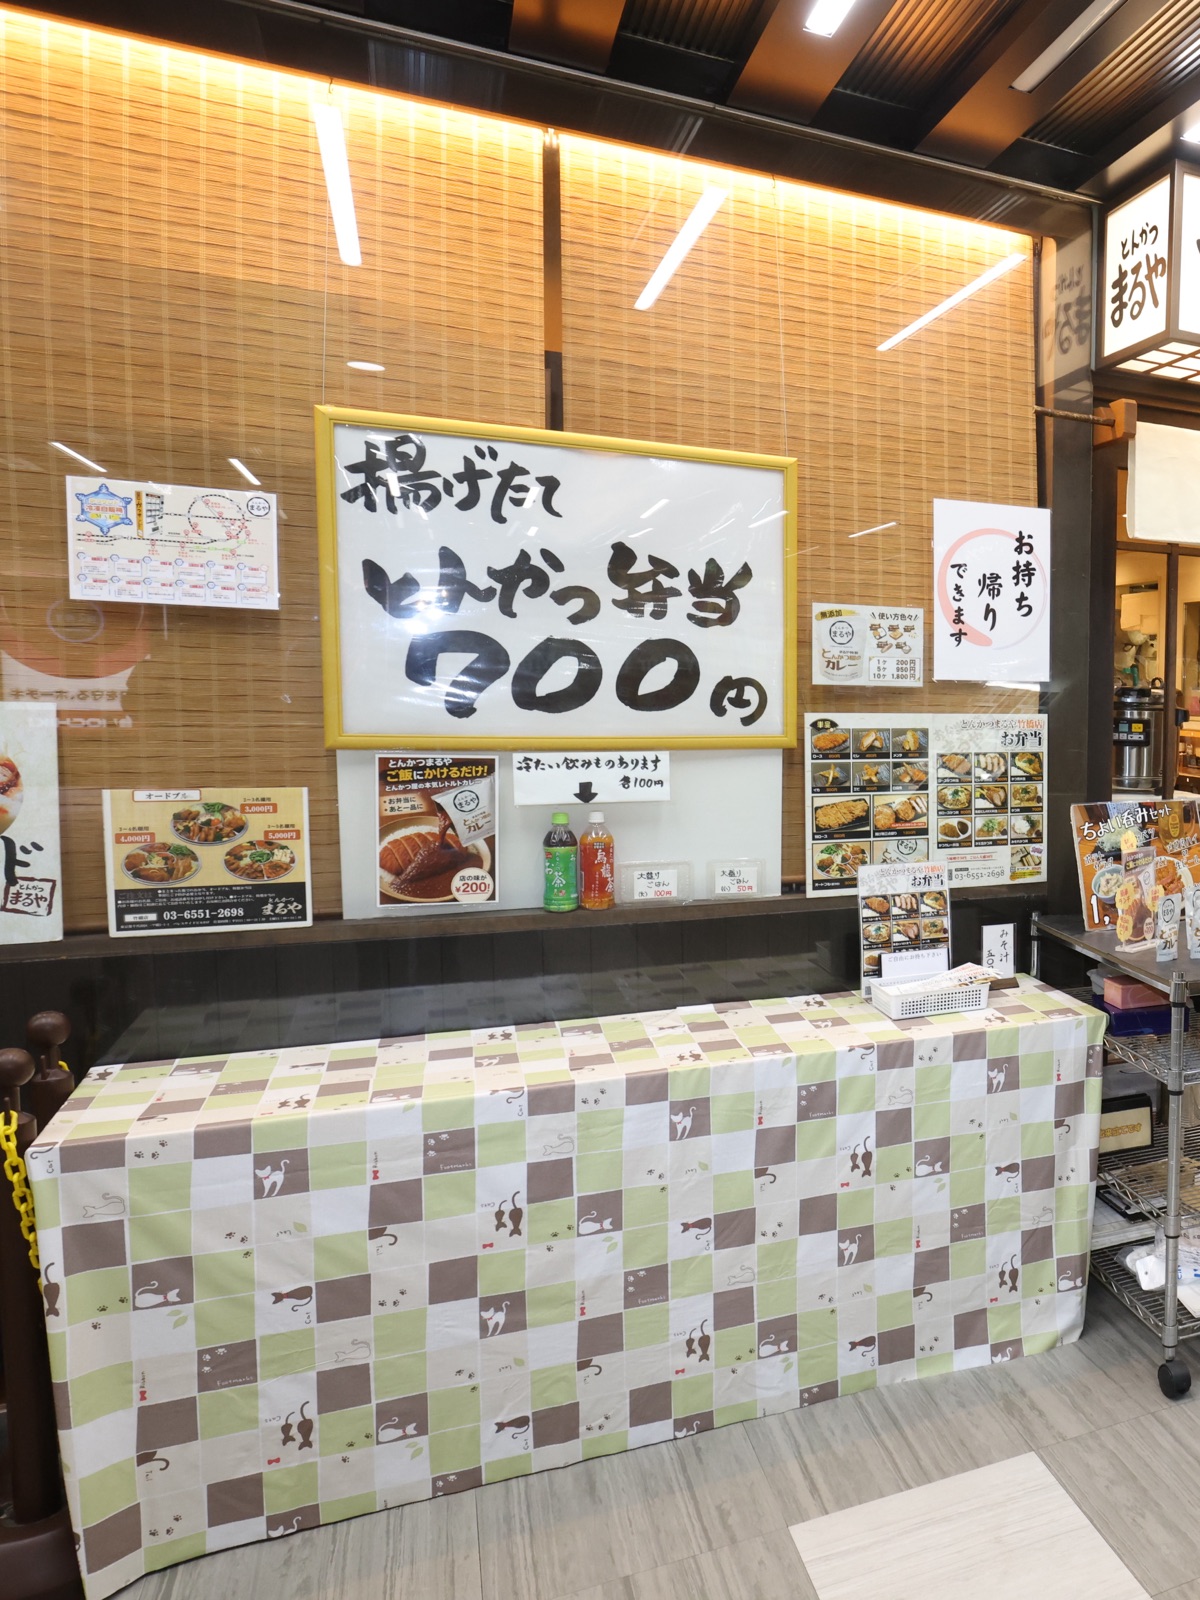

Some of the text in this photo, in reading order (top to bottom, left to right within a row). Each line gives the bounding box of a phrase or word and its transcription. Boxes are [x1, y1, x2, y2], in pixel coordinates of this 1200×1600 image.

[1121, 222, 1158, 260] とんかつ
[1111, 253, 1167, 328] まるや
[340, 434, 563, 524] 揚げたて
[1011, 530, 1037, 618] お持ち
[362, 541, 754, 629] とんかつ弁当
[949, 562, 969, 648] できます
[977, 572, 1003, 633] 帰り
[878, 612, 913, 621] 使い方色々
[832, 630, 852, 638] まるや
[825, 660, 858, 671] カレー
[896, 659, 916, 667] 200円
[404, 629, 768, 726] 700円
[961, 719, 1044, 730] とんかつまるや 竹橋店
[1001, 730, 1043, 747] お弁当
[388, 758, 453, 768] とんかつまるや
[516, 756, 661, 772] 冷たい飲みものあります
[1081, 804, 1172, 841] ちょい呑みセット
[730, 878, 749, 886] ごはん
[911, 874, 944, 888] お弁当
[954, 869, 1005, 881] 03-6551-2698
[9, 890, 48, 908] まるや
[653, 889, 672, 897] 100円
[163, 908, 245, 921] 03-6551-2698
[261, 903, 302, 916] まるや
[999, 929, 1009, 963] みそ汁
